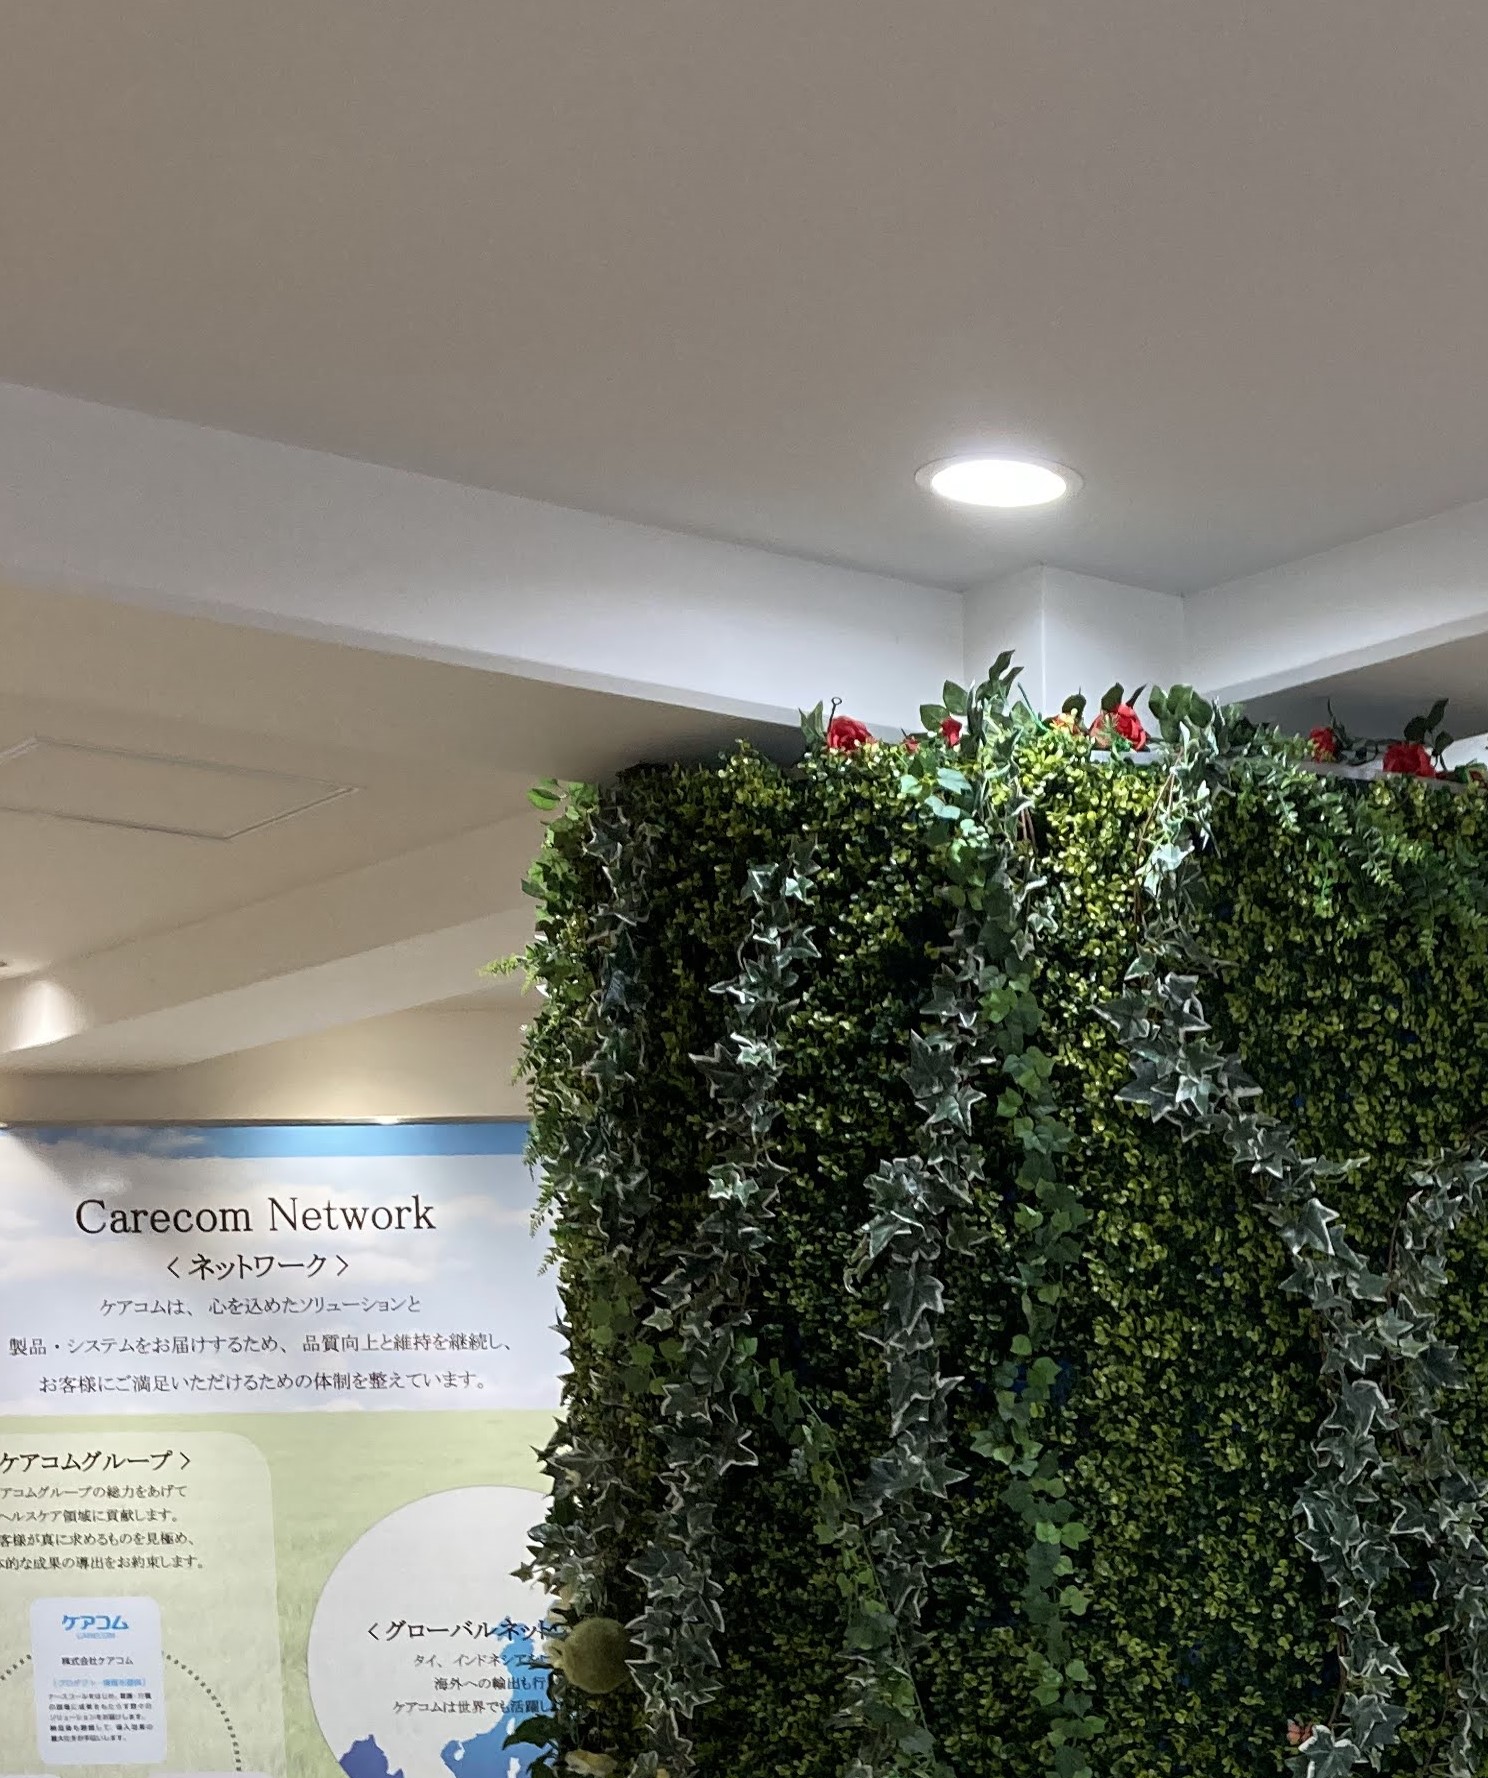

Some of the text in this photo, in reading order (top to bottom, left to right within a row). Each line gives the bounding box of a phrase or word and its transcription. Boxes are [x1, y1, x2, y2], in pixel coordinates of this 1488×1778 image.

[75, 1195, 437, 1235] Carecom Network
[62, 1615, 129, 1631] ケアコム
